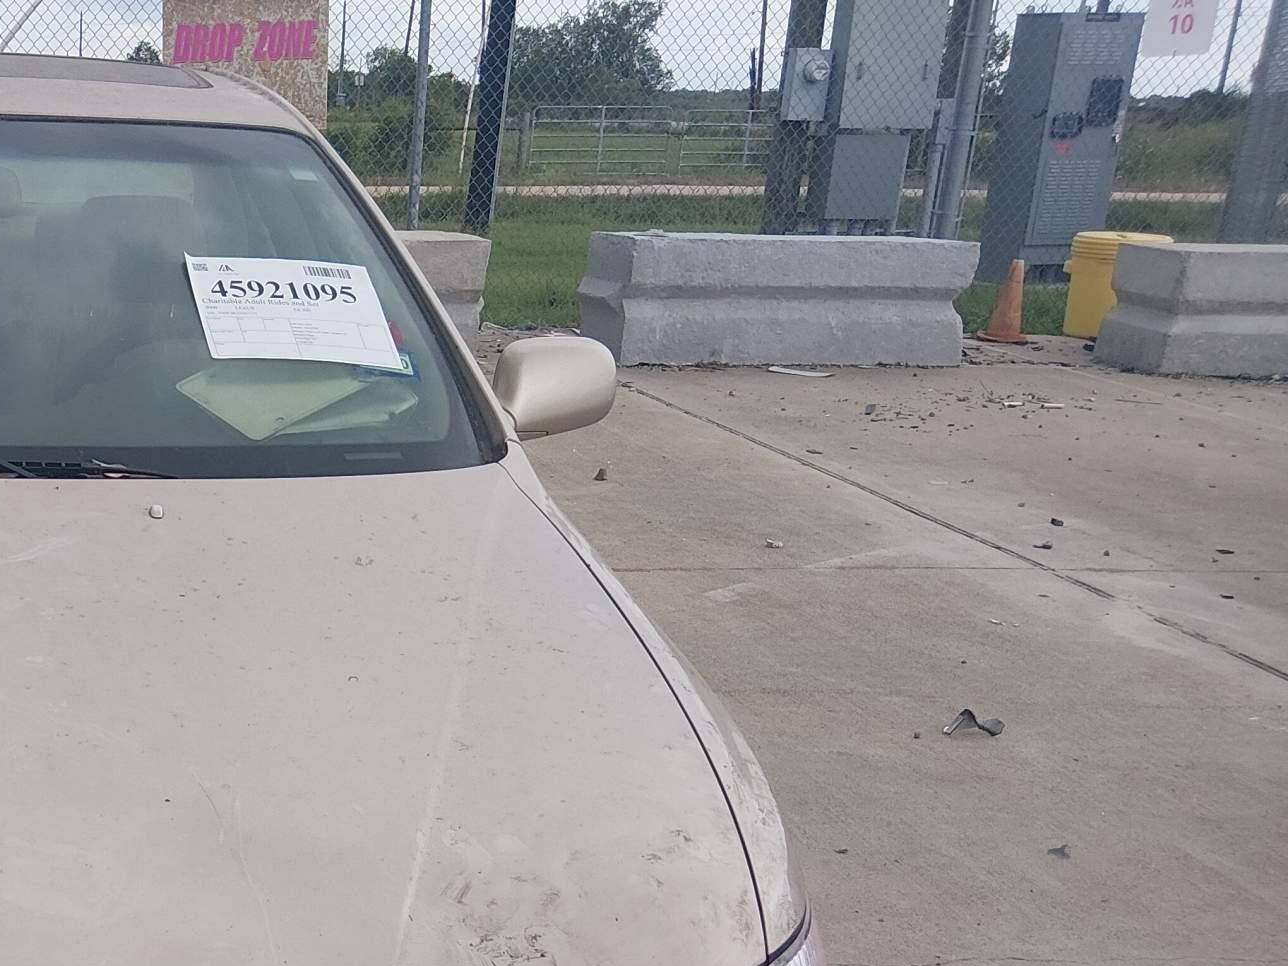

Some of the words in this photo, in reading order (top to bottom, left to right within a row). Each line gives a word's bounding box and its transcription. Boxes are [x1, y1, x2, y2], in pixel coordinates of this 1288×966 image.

[1168, 13, 1195, 35] 10
[174, 22, 243, 64] DROP
[254, 20, 319, 62] ZONE
[211, 279, 357, 304] 45921095
